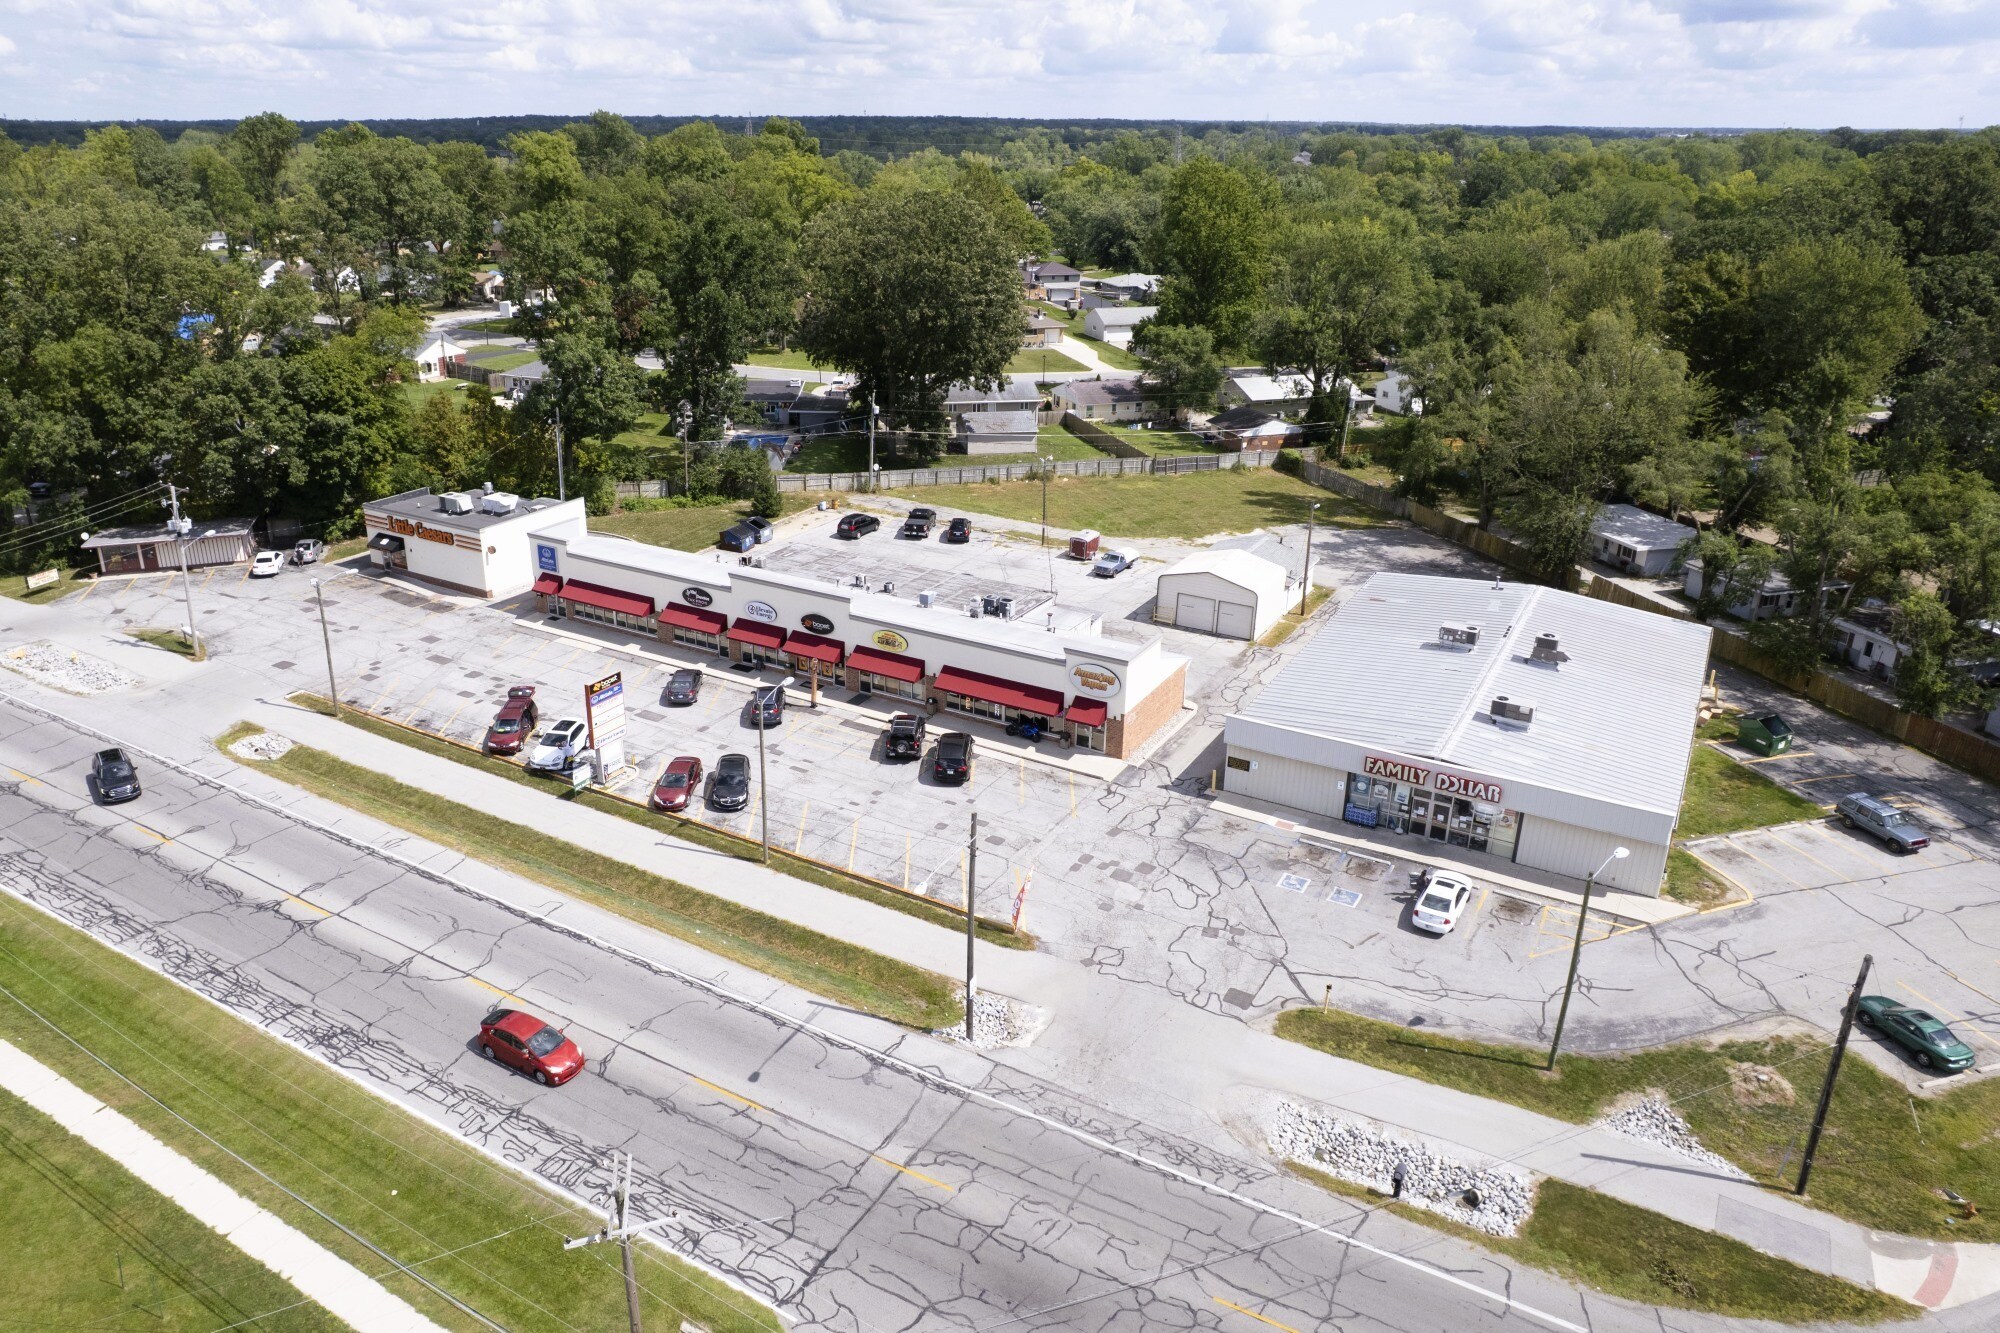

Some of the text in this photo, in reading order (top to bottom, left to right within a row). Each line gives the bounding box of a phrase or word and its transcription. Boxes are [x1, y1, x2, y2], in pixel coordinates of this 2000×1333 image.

[387, 515, 454, 545] Little Caesars
[1073, 666, 1116, 685] Amazing
[1081, 677, 1108, 691] Vapes
[1364, 756, 1430, 785] FAMILY
[1435, 772, 1502, 803] DOLLAR
